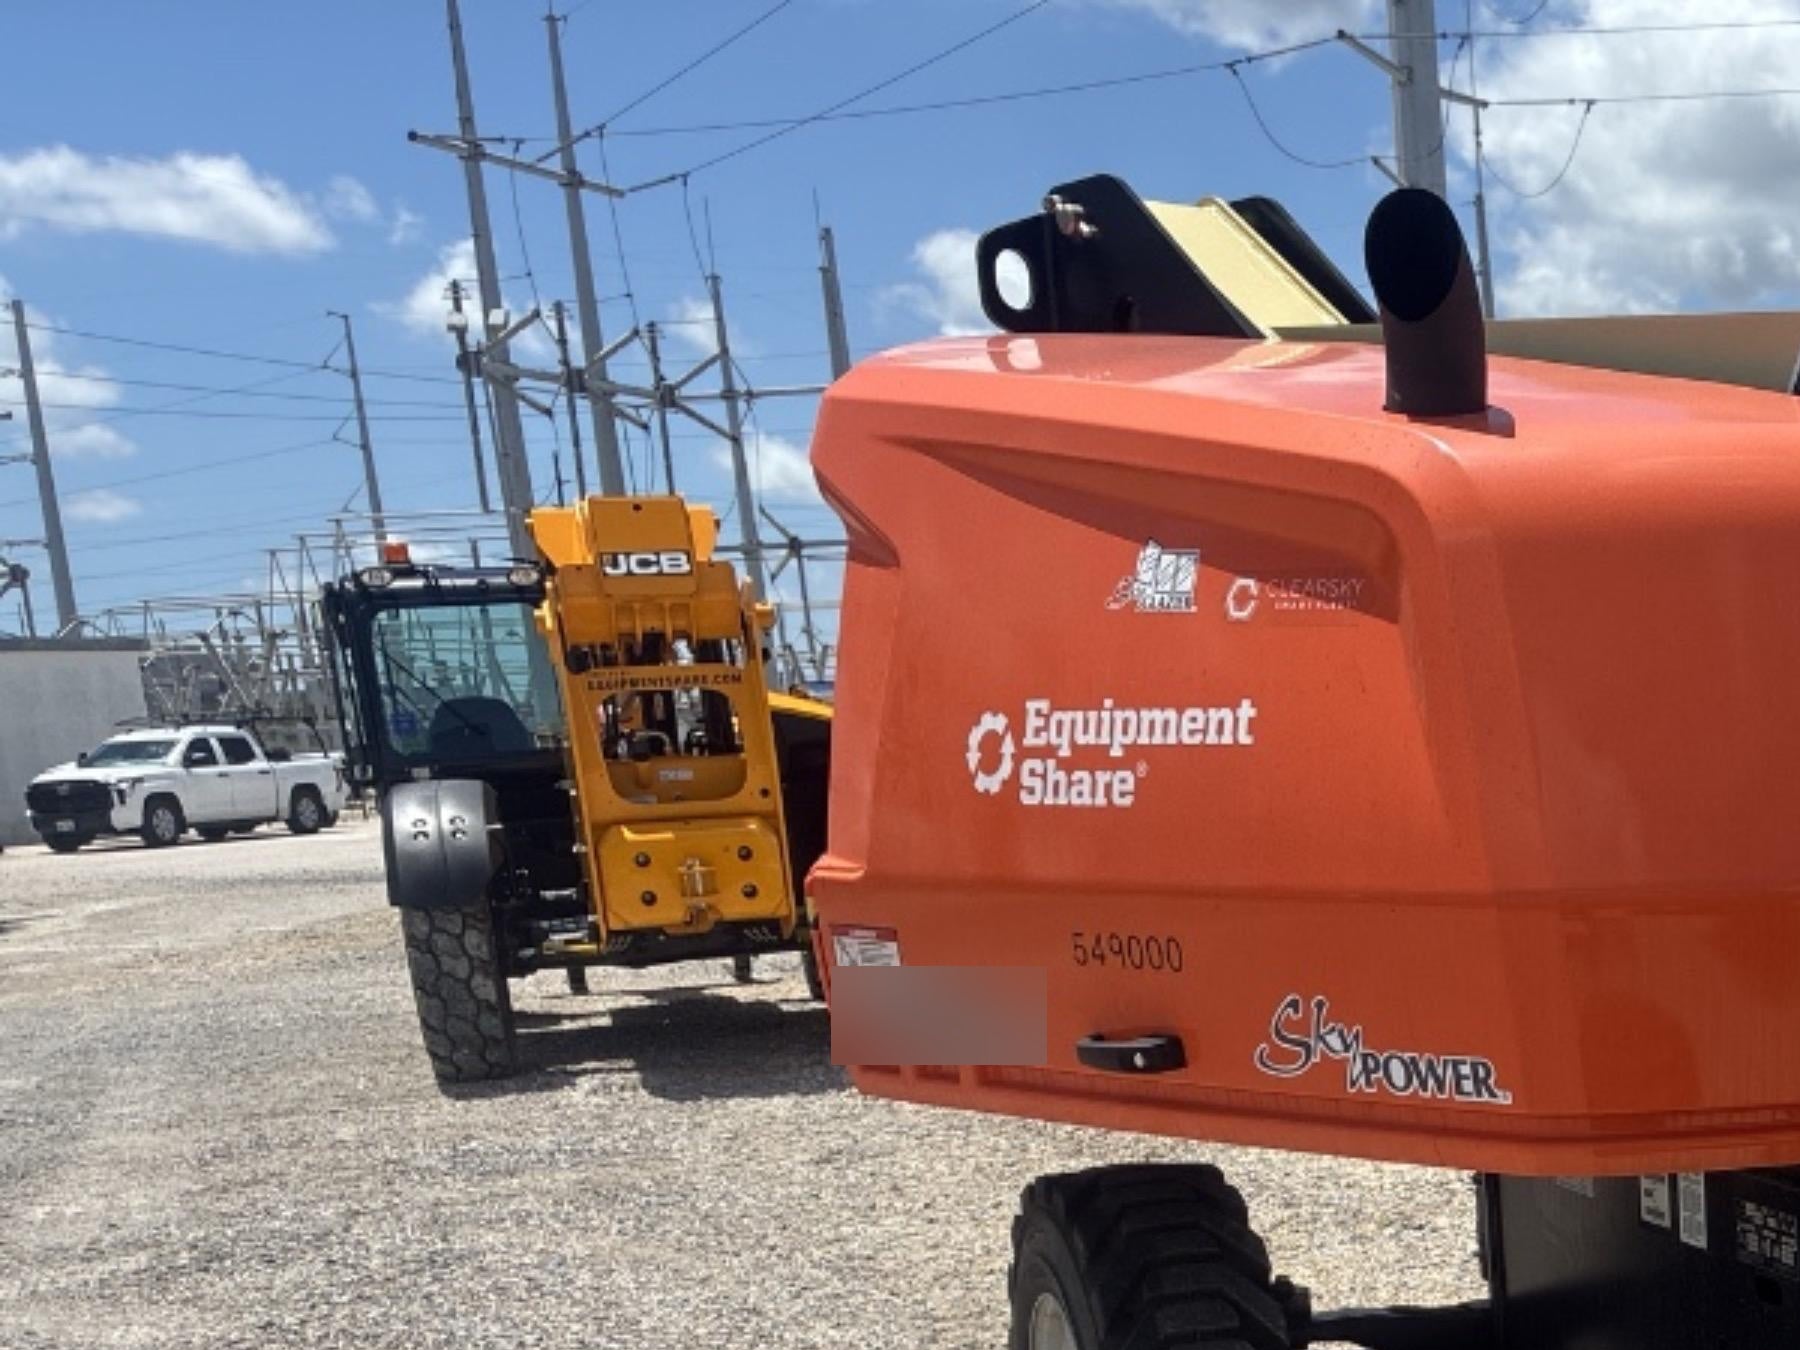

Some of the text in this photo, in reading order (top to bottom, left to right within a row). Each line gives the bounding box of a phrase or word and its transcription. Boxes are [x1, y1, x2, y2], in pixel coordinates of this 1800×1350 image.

[602, 552, 691, 577] JCB
[1022, 697, 1257, 757] Equipment
[1071, 932, 1183, 973] 549000
[1254, 994, 1362, 1092] Sky
[1360, 1050, 1503, 1101] POWER
